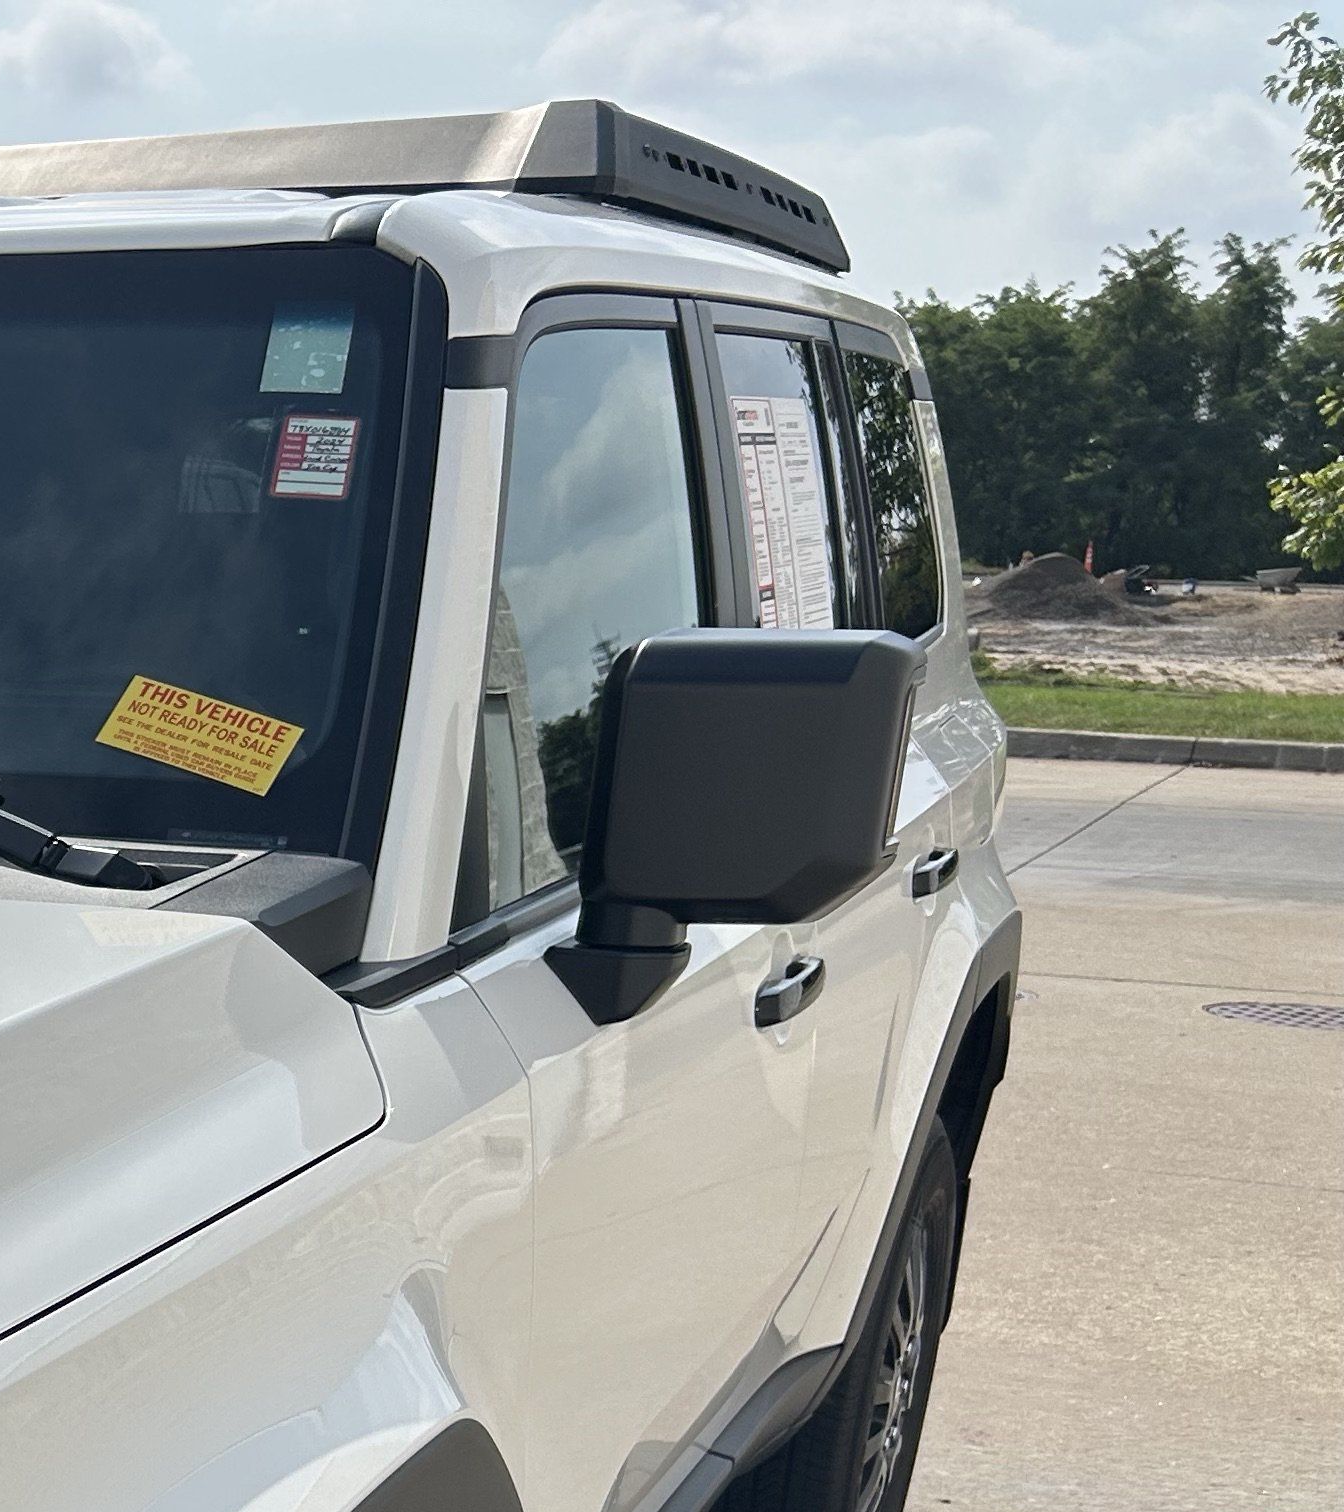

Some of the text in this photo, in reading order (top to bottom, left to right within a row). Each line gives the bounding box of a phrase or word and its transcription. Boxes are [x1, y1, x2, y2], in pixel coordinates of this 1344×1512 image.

[128, 700, 278, 758] NOT READY FOR SALE
[139, 681, 292, 743] THIS VEHICLE
[117, 715, 273, 770] SEE THE DEALER FOR RESALE DATE
